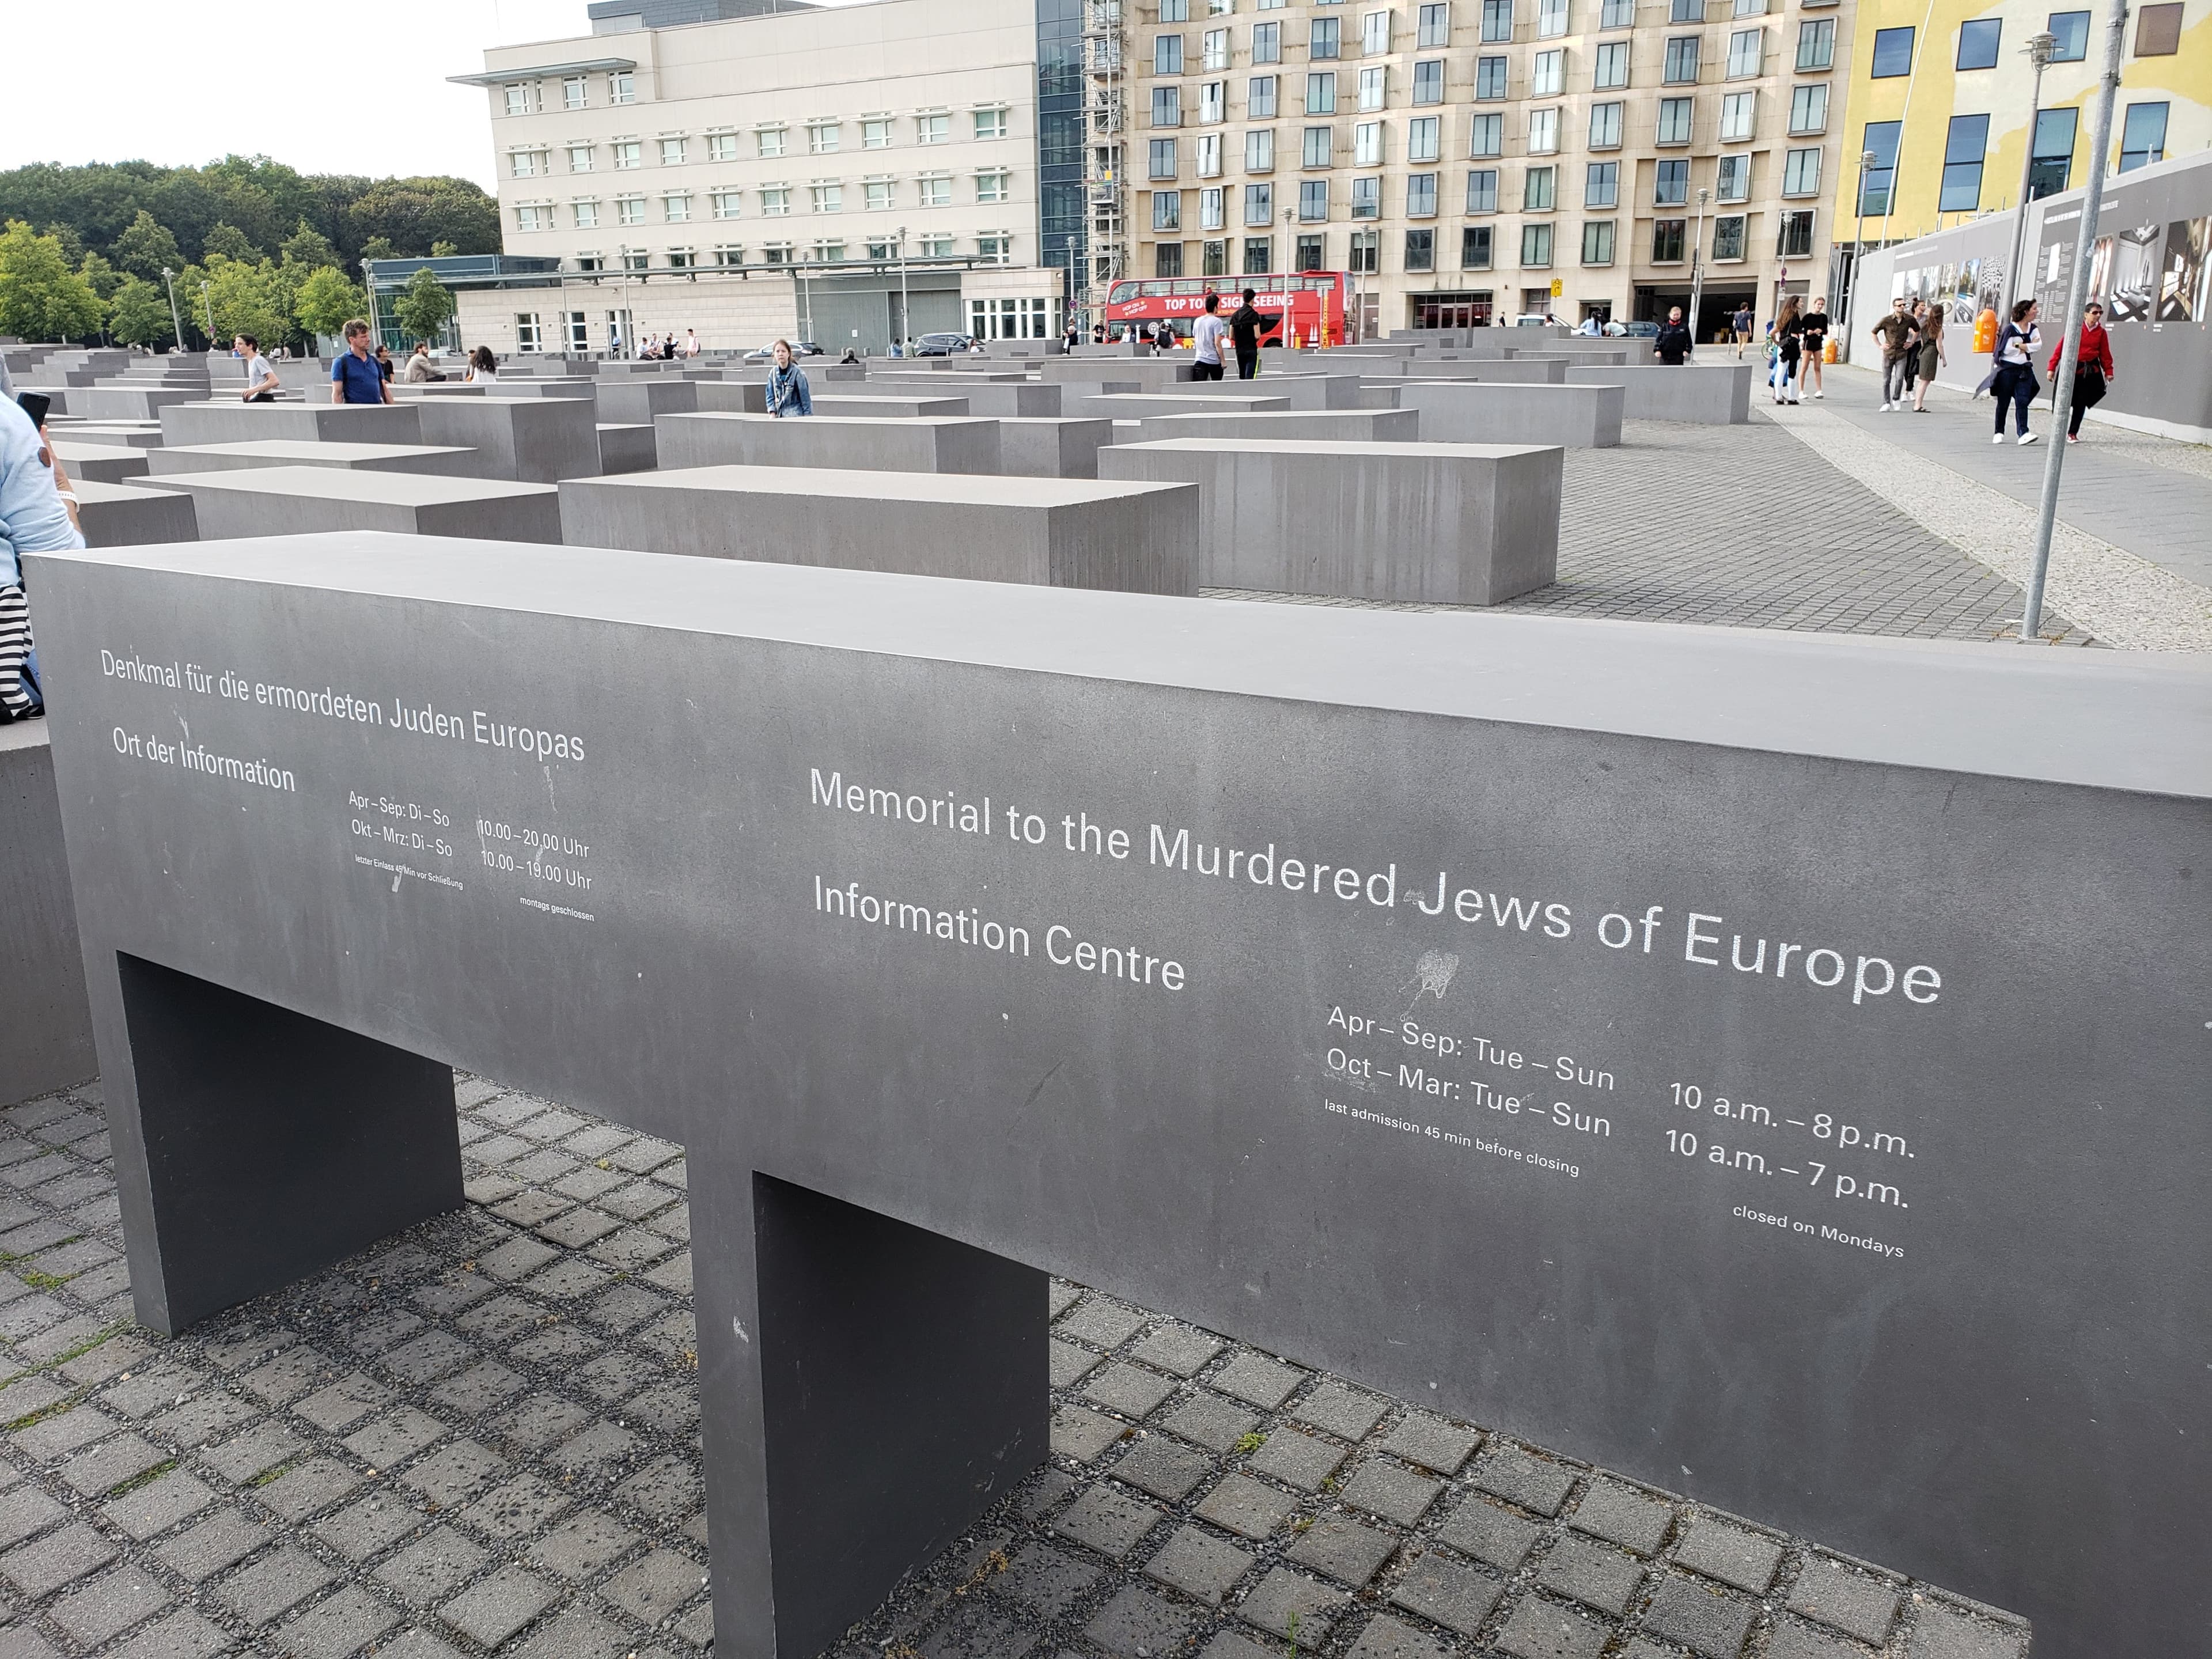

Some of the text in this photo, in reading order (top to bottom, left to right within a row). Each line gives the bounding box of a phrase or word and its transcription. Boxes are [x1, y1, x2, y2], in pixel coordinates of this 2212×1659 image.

[1165, 299, 1186, 310] TOP
[101, 650, 584, 762] Denkmal für die ermordeten Juden Europas
[113, 728, 295, 791] Ort der Information
[355, 854, 373, 865] letzter
[374, 859, 394, 871] Einlass
[403, 866, 415, 876] Min
[429, 873, 463, 890] Schließung
[563, 837, 589, 857] Uhr
[521, 898, 594, 921] montags geschlossen
[566, 869, 591, 889] Uhr
[812, 768, 1940, 1004] Memorial to the Murdered Jews of Europe
[816, 876, 1184, 990] Information Centre
[1325, 1099, 1578, 1177] last admission 45 min before closing
[1671, 1083, 1701, 1109] 10
[1714, 1099, 1777, 1127] a.m.
[1813, 1114, 1832, 1138] 8
[1840, 1126, 1914, 1158] p.m.
[1666, 1130, 1696, 1156] 10
[1709, 1146, 1772, 1175] a.m.
[1809, 1162, 1825, 1185] 7
[1836, 1175, 1907, 1207] p.m.
[1734, 1206, 1903, 1257] closed on Mondays
